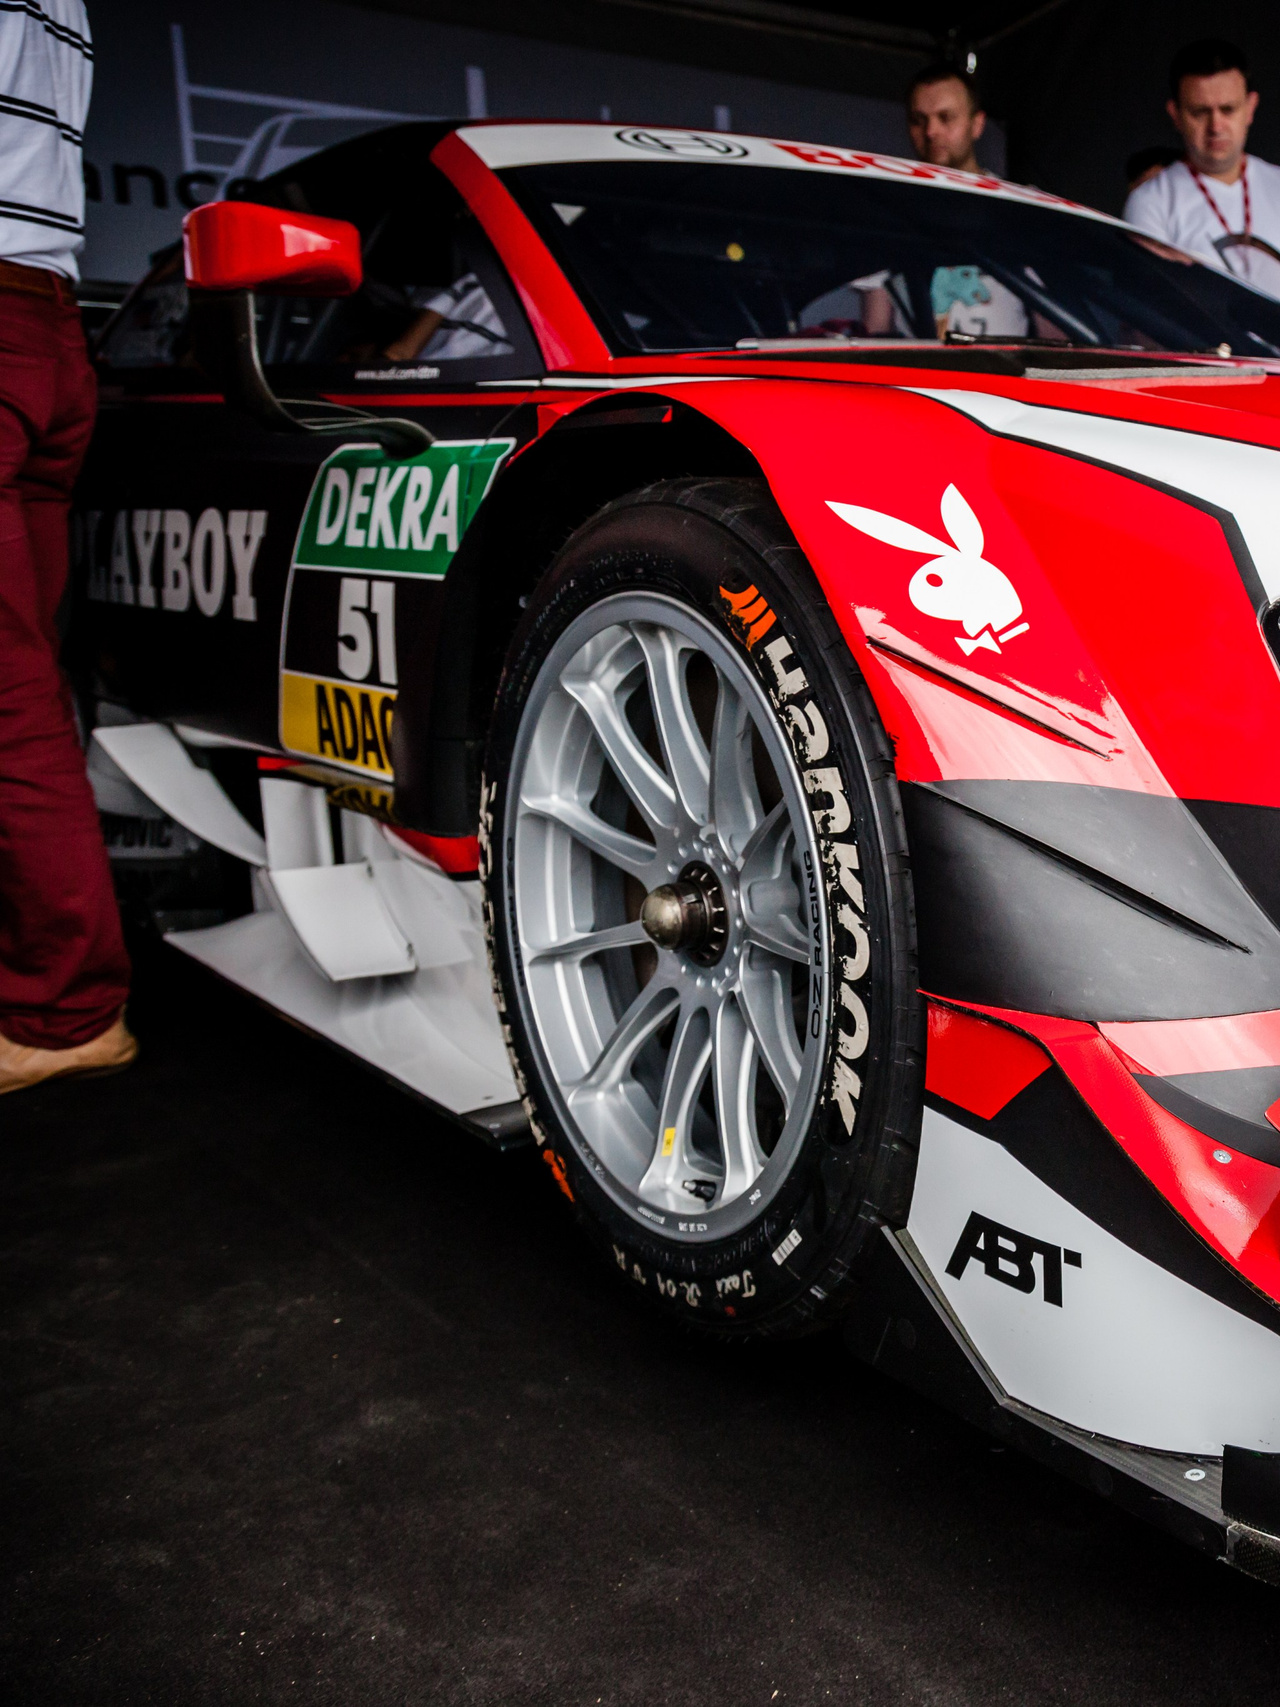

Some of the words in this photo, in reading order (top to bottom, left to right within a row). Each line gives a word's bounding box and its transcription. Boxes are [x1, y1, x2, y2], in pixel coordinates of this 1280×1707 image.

[315, 463, 461, 553] DEKRA
[337, 578, 399, 686] 51
[803, 850, 822, 967] RACING
[944, 1210, 1083, 1308] ABT
